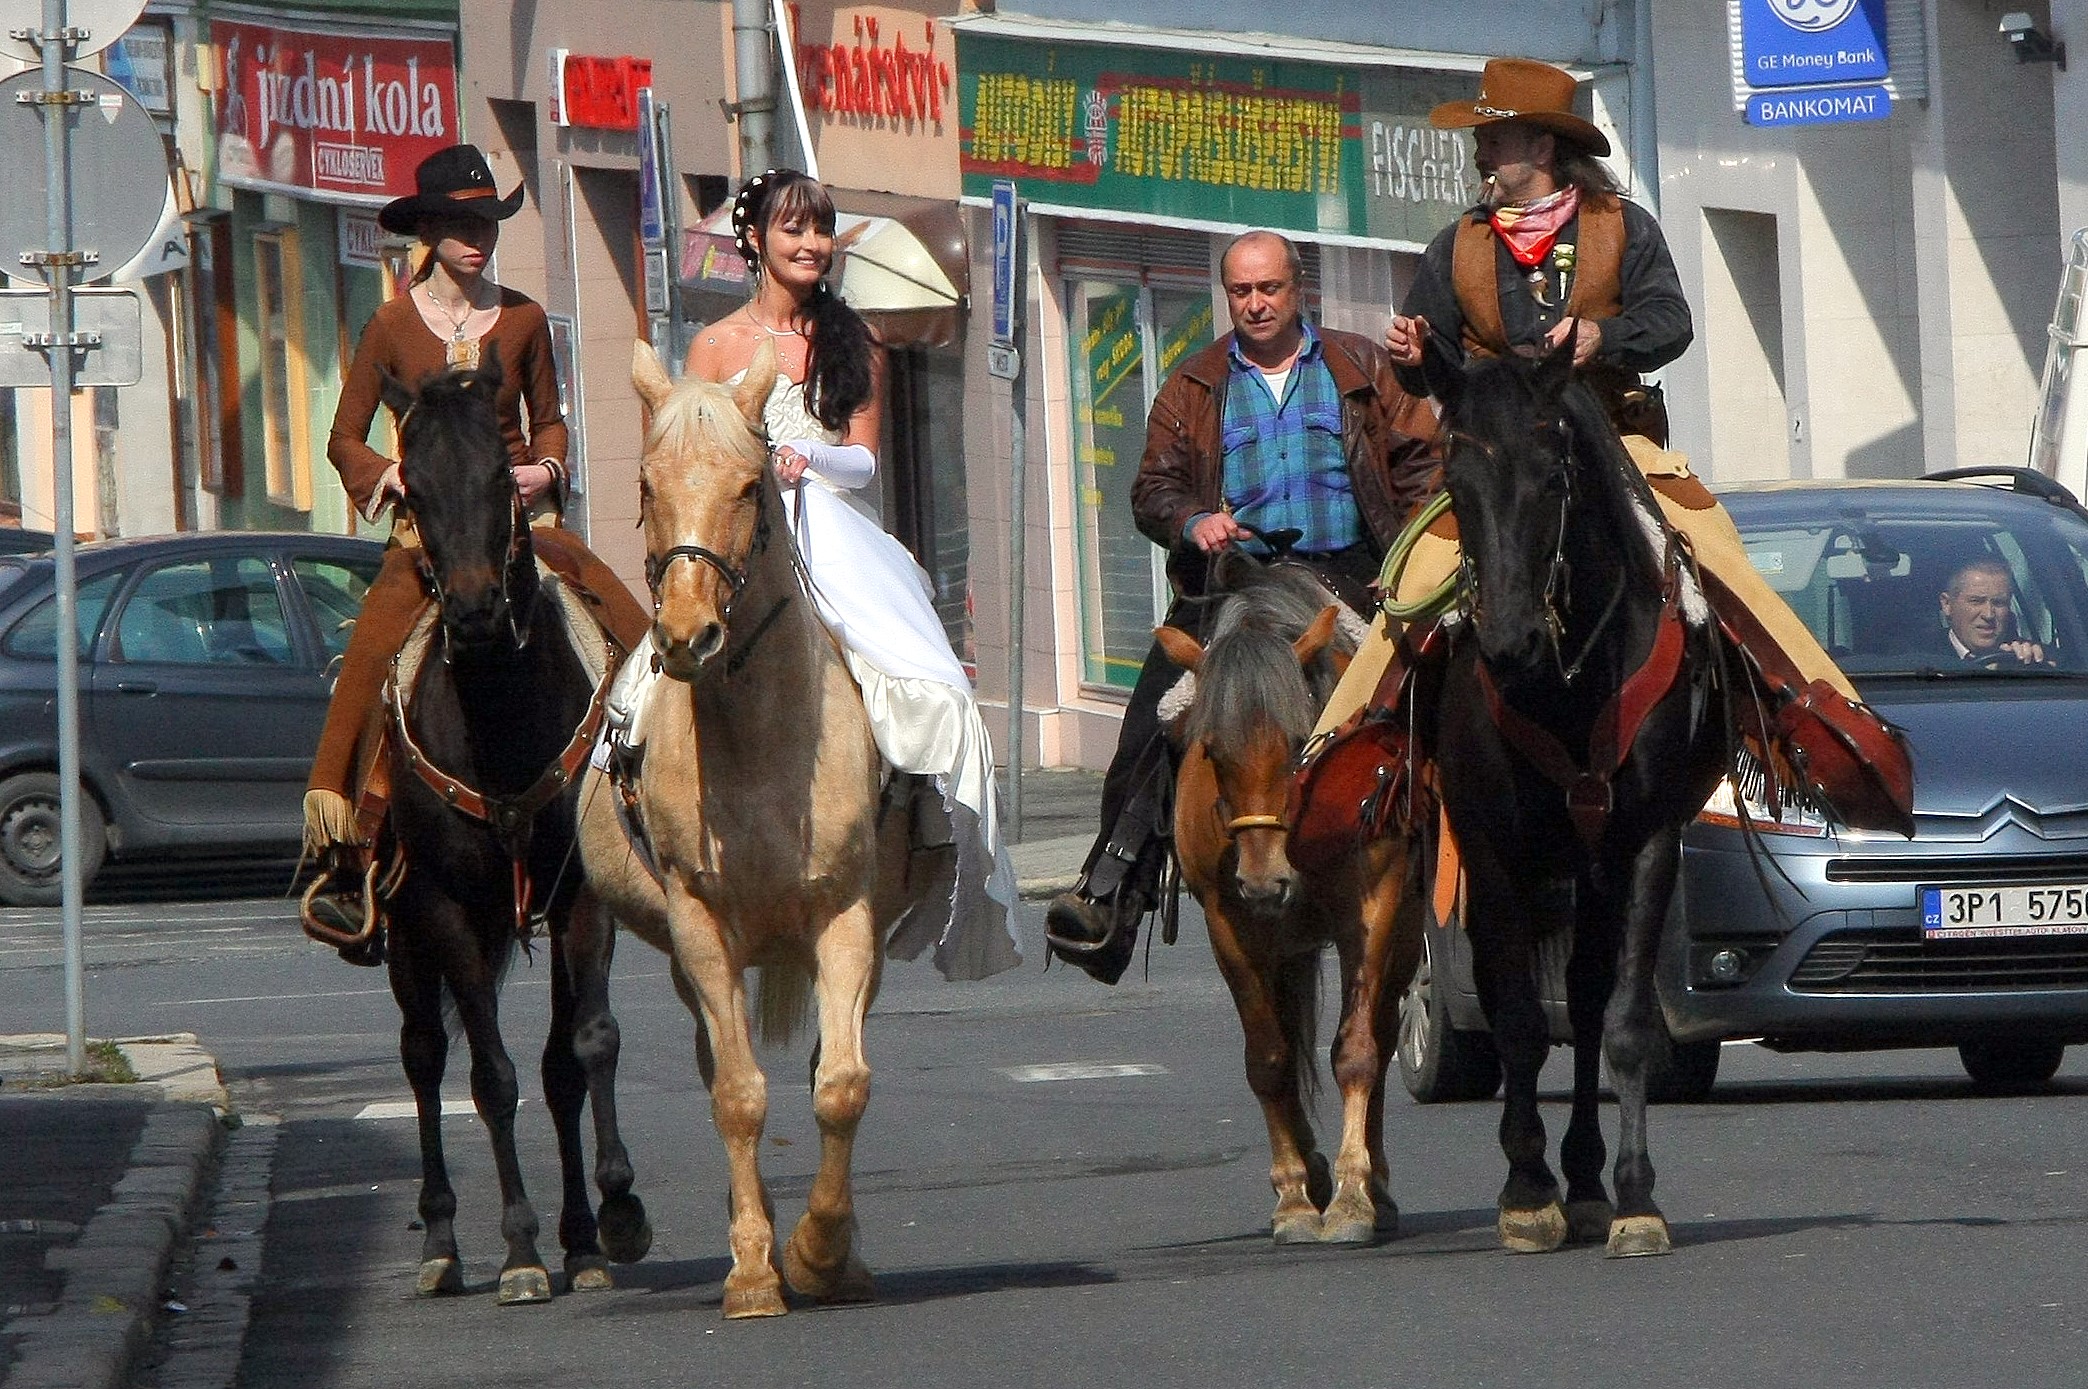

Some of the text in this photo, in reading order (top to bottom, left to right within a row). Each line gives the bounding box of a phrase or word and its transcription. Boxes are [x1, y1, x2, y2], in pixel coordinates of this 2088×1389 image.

[1758, 49, 1875, 69] GE Money Bank
[363, 53, 444, 137] kola
[1761, 95, 1876, 120] BANKOMAT
[1372, 121, 1467, 206] FISCHER
[1925, 914, 1940, 925] CZ
[1949, 889, 2088, 923] 3P1 575
